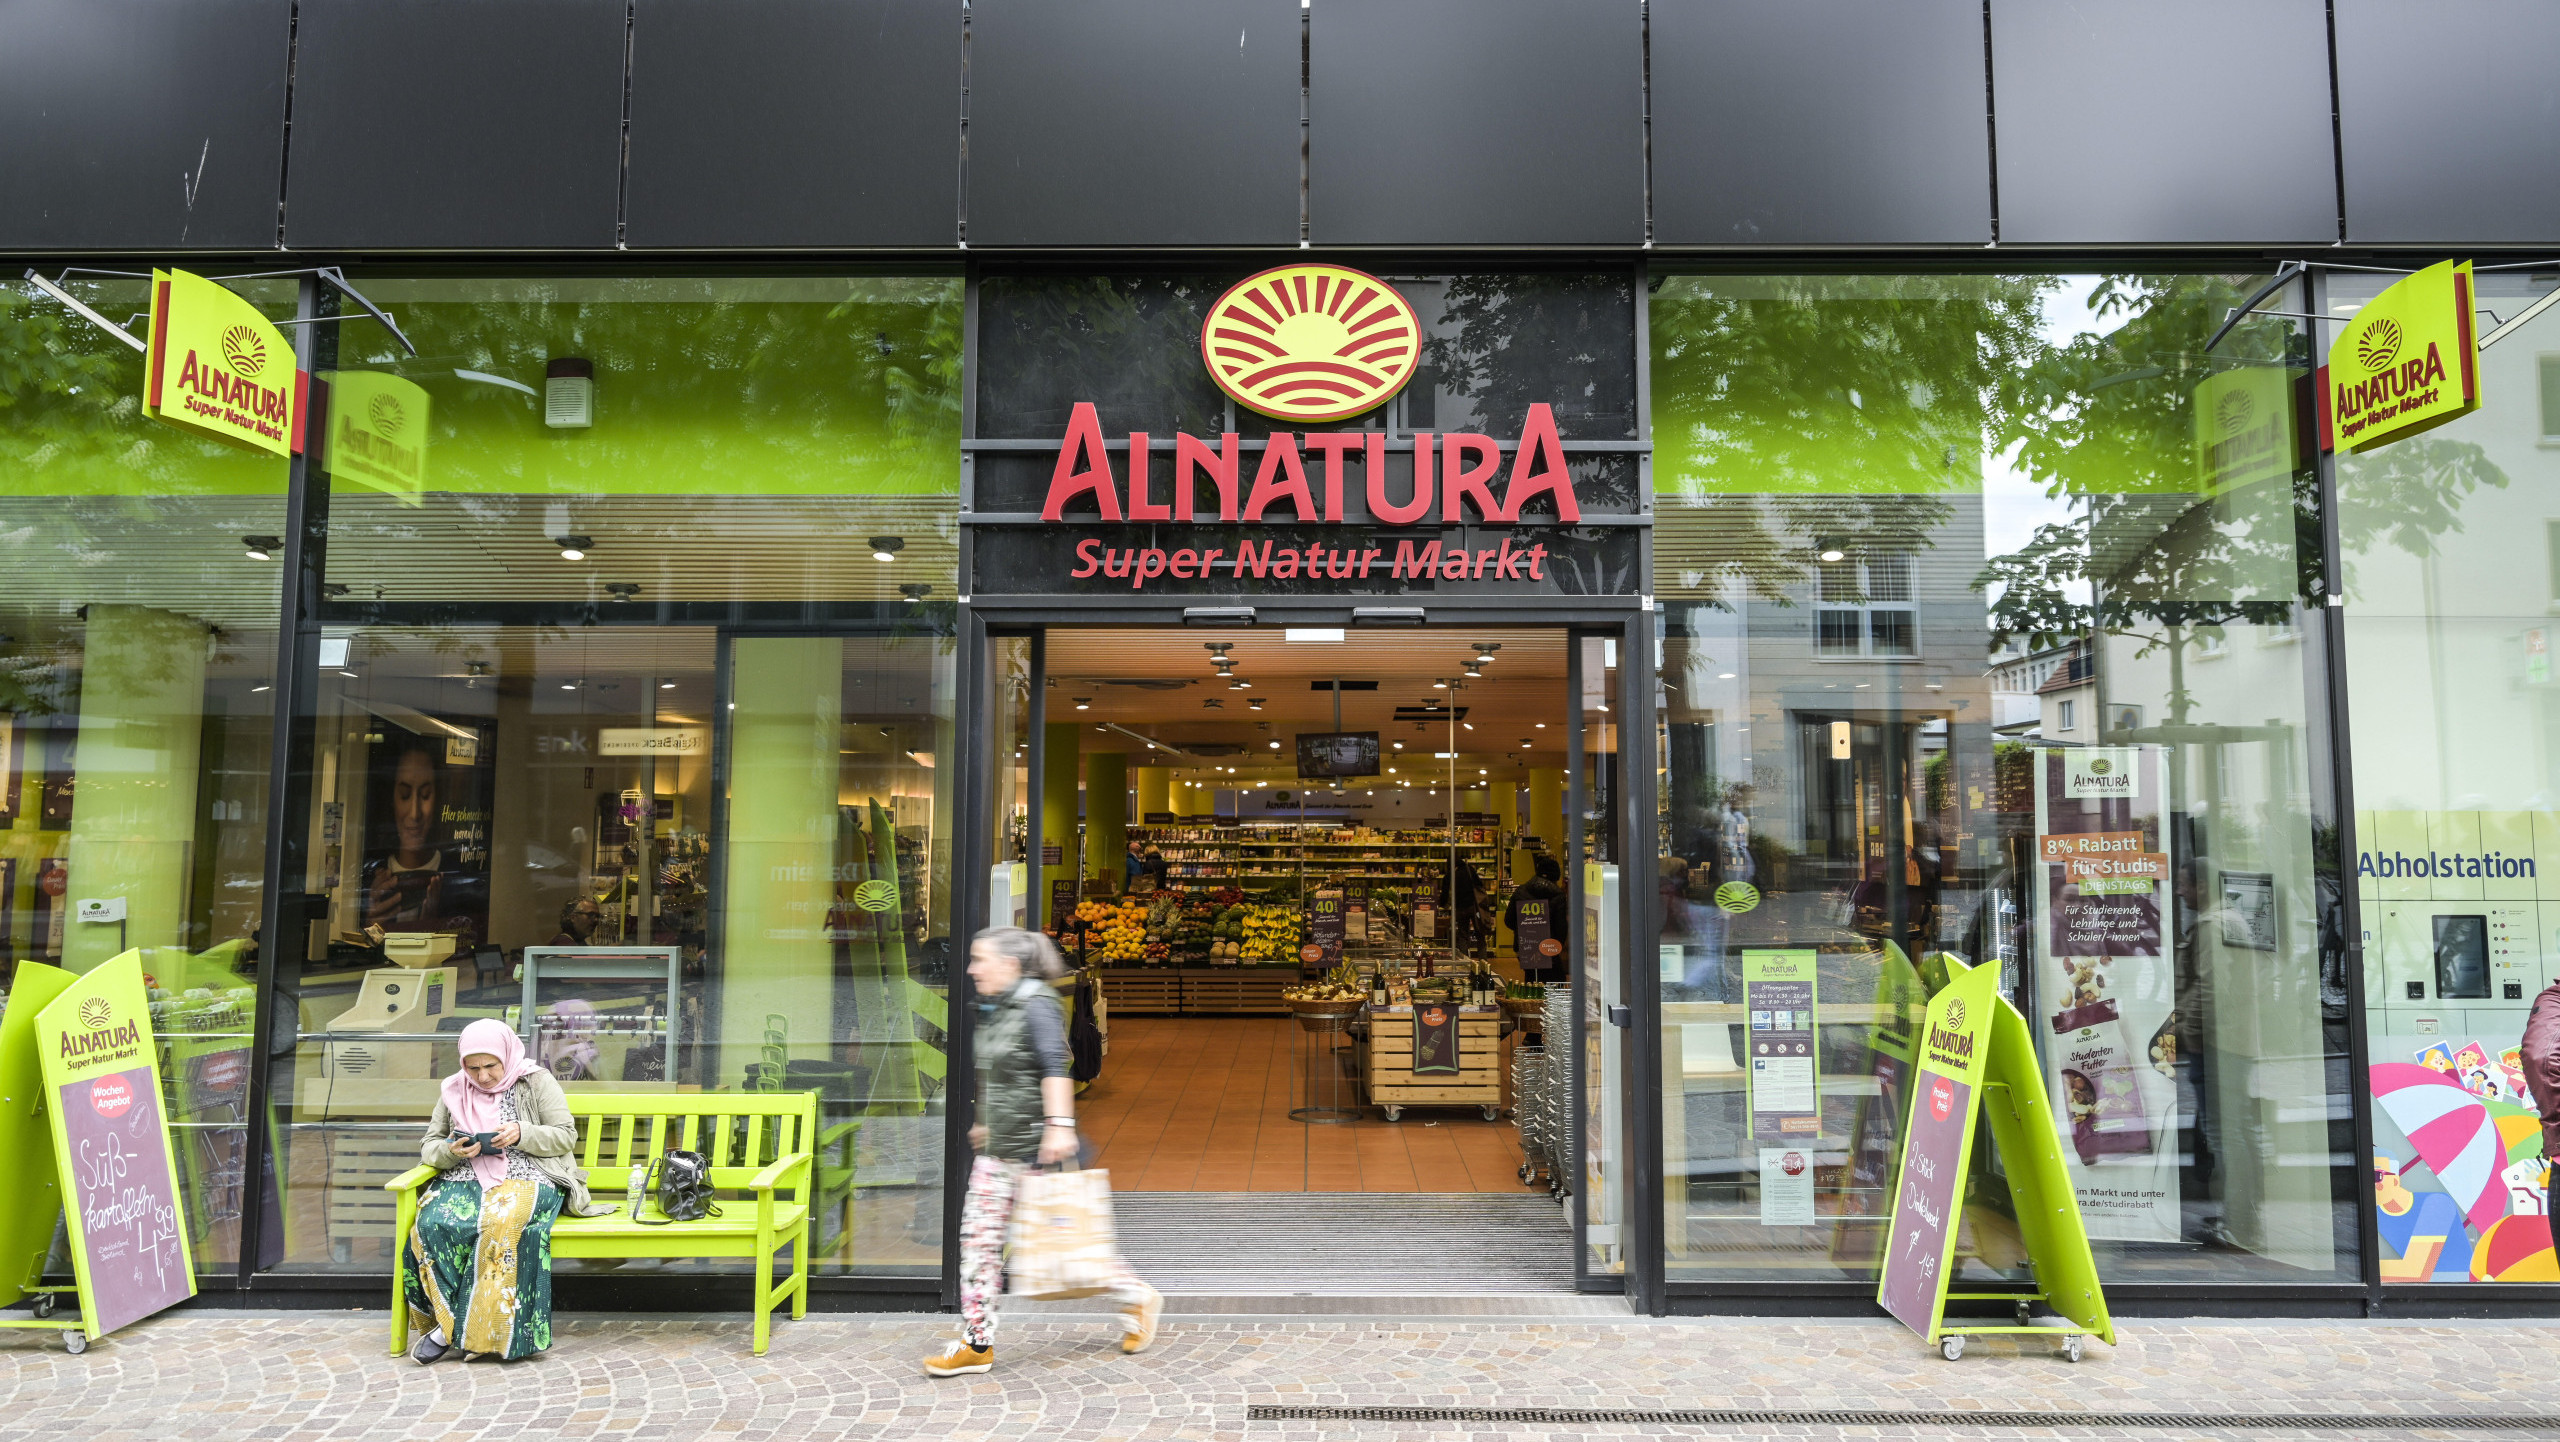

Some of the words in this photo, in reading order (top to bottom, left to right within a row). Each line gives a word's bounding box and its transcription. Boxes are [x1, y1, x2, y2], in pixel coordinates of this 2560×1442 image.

[178, 348, 289, 427] ALNATURA
[2336, 341, 2446, 423] ALNATURA
[184, 395, 223, 417] Super
[223, 408, 256, 430] Natur
[255, 419, 283, 441] Markt
[2341, 417, 2367, 438] Super
[2367, 405, 2398, 426] Natur
[2399, 388, 2439, 413] Markt
[1040, 402, 1582, 524] ALNATURA
[1070, 537, 1225, 588] Super
[1232, 539, 1384, 579] Natur
[1391, 537, 1548, 581] Markt
[2073, 773, 2130, 787] ALNATURA
[2047, 839, 2073, 855] 8%
[2079, 836, 2137, 852] Rabatt
[2072, 860, 2097, 875] für
[2102, 858, 2157, 875] Studis
[2358, 851, 2535, 878] Abholstation
[2085, 879, 2146, 892] DIENSTAGS
[1315, 901, 1334, 913] 40
[1521, 903, 1540, 915] 40
[2064, 905, 2079, 915] Für
[2081, 904, 2144, 917] Studierende,
[2070, 919, 2115, 931] Lehrlinge
[2118, 919, 2138, 928] und
[1761, 964, 1798, 974] ALNATURA
[61, 1019, 140, 1058] ALNATURA
[1928, 1021, 1973, 1059] ALNATURA
[2076, 1032, 2100, 1043] ALNATURA
[67, 1059, 91, 1070] Super
[92, 1053, 114, 1065] Natur
[115, 1047, 138, 1060] Markt
[1928, 1050, 1941, 1062] Super
[1939, 1054, 1955, 1066] Natur
[1954, 1058, 1968, 1070] Markt
[2070, 1046, 2114, 1061] Studenten
[2081, 1059, 2109, 1071] Futter
[93, 1085, 125, 1097] Wochen
[1932, 1086, 1950, 1100] Probier
[97, 1095, 131, 1109] Angebot
[1936, 1100, 1948, 1112] Preis
[1909, 1141, 1919, 1169] 2
[80, 1132, 138, 1194] Süß-
[2076, 1187, 2088, 1196] im
[2090, 1188, 2118, 1197] Markt
[2121, 1188, 2139, 1198] und
[2141, 1189, 2166, 1198] unter
[2077, 1199, 2154, 1209] ra.de/studirabatt
